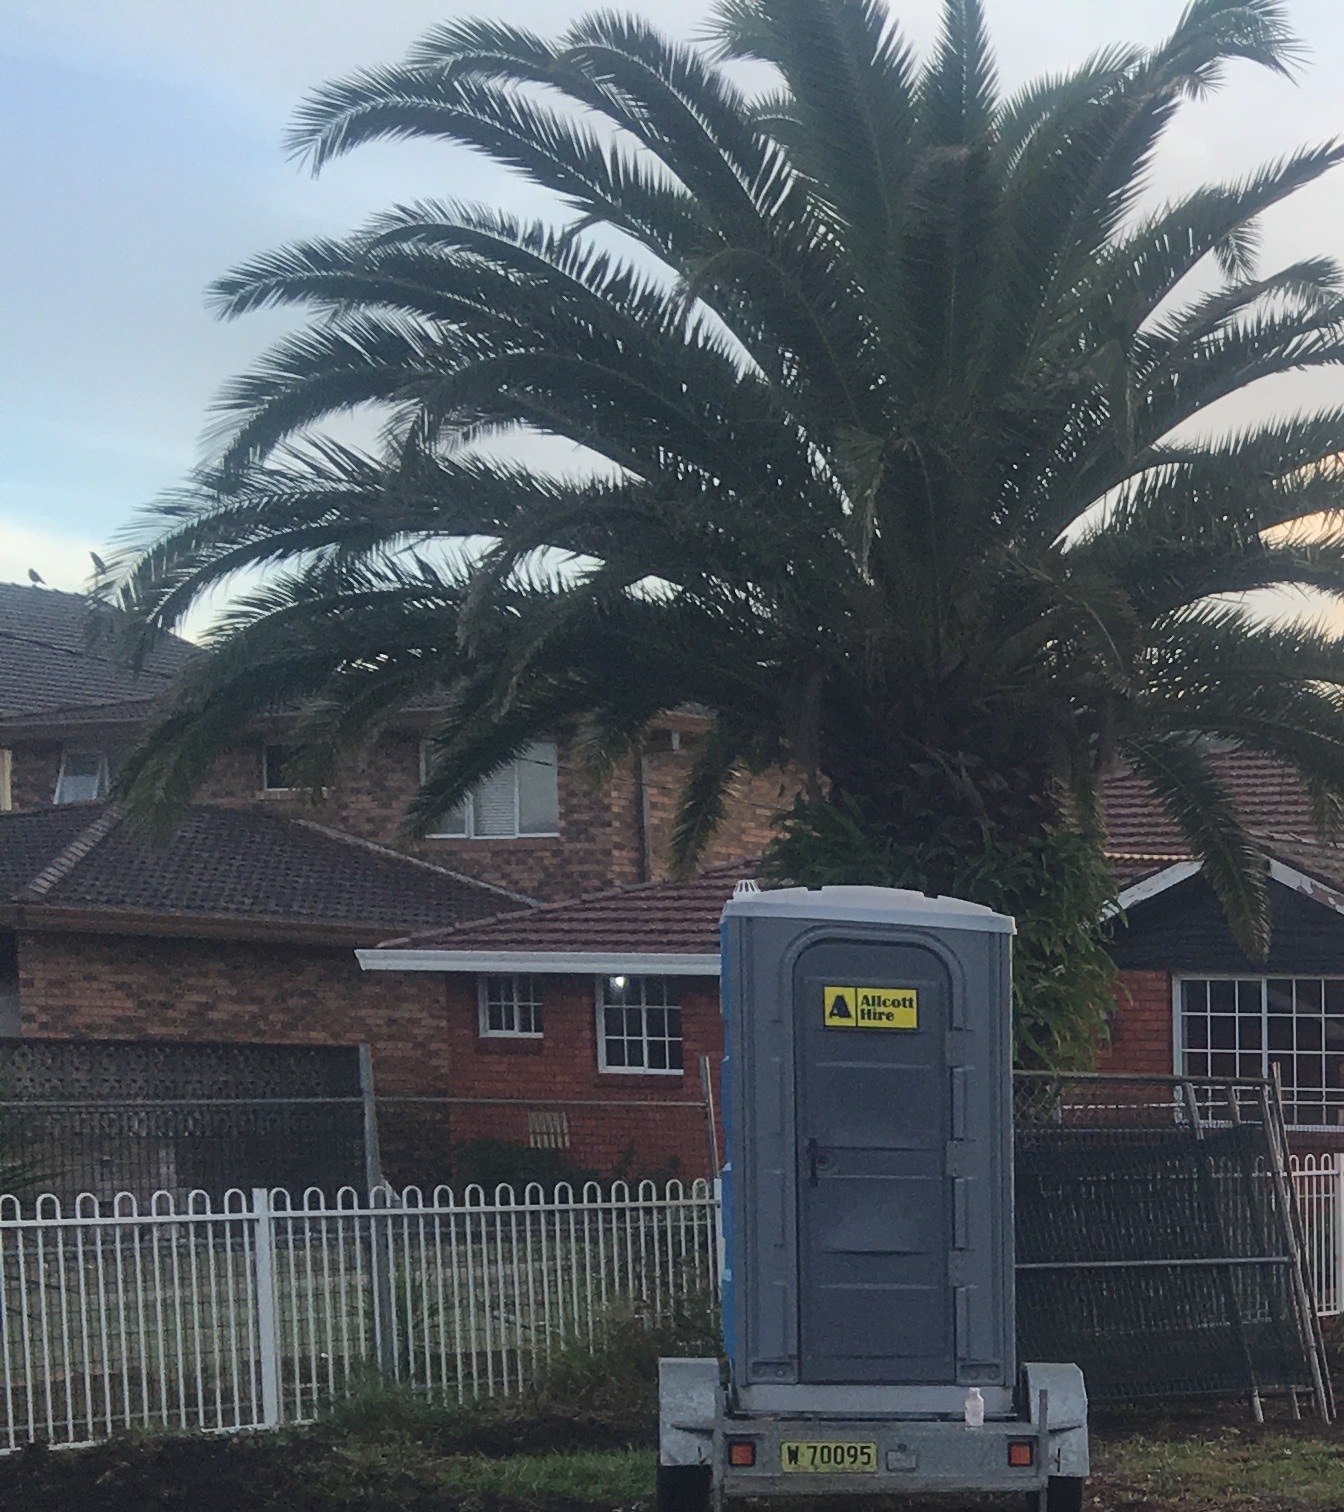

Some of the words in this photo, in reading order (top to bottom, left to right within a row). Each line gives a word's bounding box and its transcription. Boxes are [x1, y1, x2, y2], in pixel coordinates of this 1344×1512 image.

[860, 994, 915, 1009] Allcott
[860, 1008, 895, 1022] Hire
[806, 1445, 872, 1466] 70095
